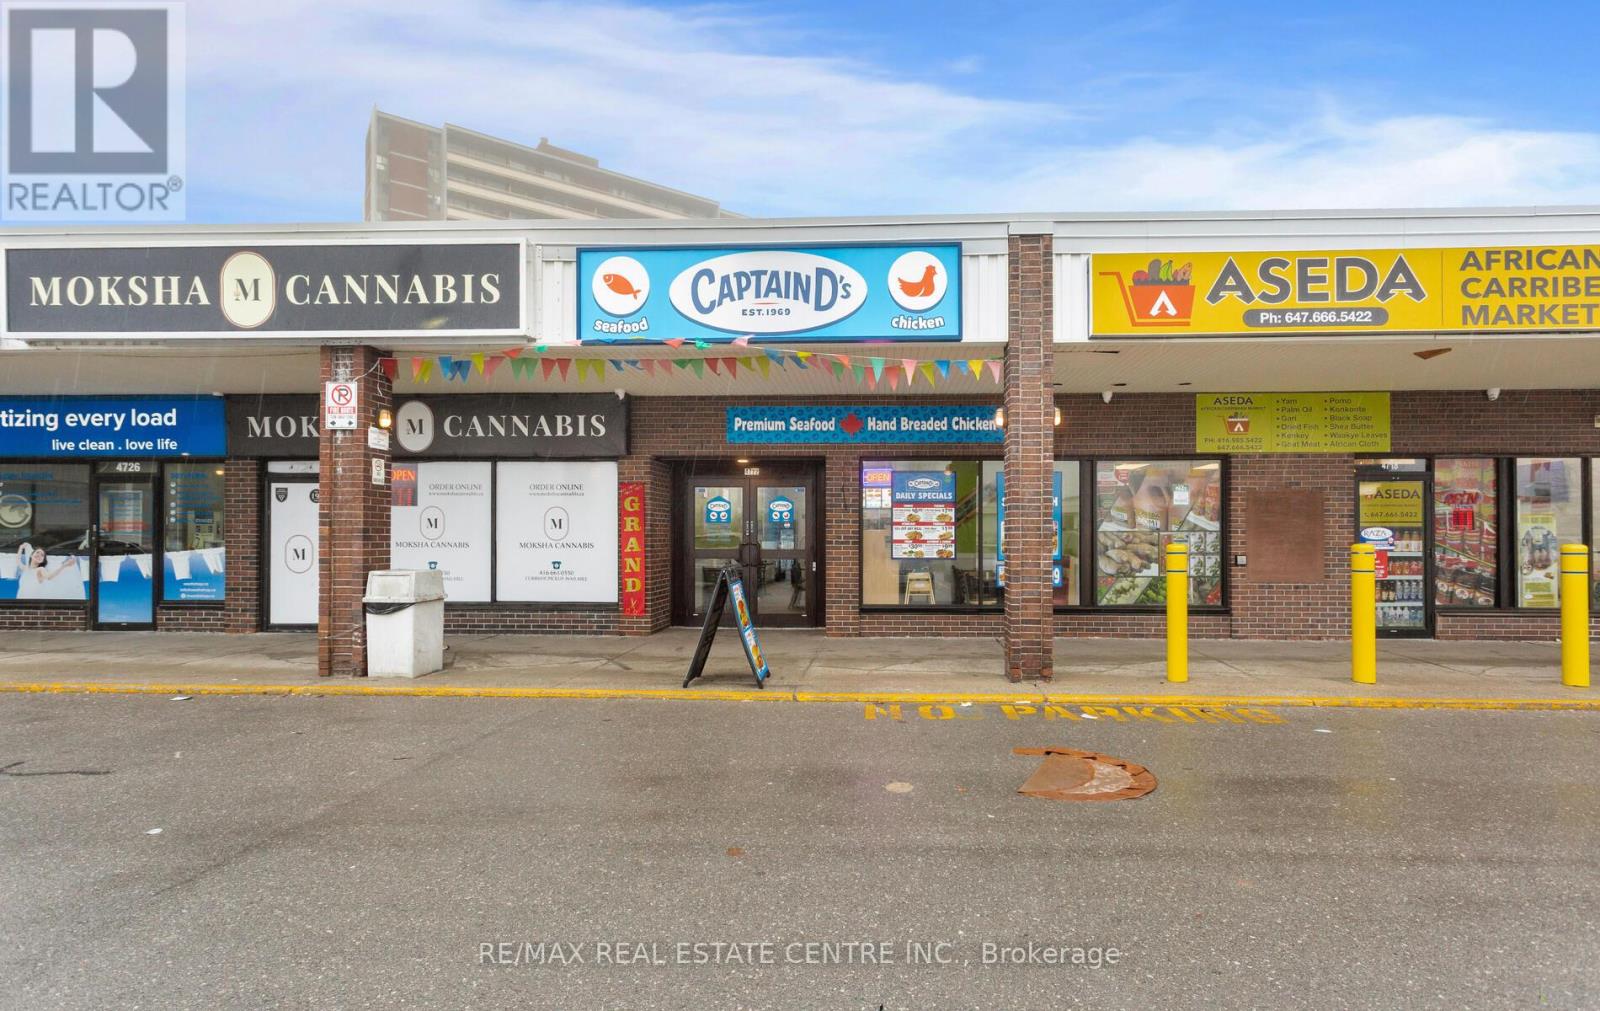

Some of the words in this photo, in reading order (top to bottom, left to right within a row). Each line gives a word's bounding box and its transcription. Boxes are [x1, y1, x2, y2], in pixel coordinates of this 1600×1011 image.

[1460, 249, 1600, 271] AFRICAN
[1205, 254, 1427, 306] ASEDA
[1461, 276, 1600, 299] CARRIBE
[29, 275, 212, 307] MOKSHA
[285, 272, 501, 306] CANNABIS
[890, 314, 945, 331] chicken
[1259, 312, 1283, 325] Ph:
[1284, 310, 1373, 324] 647.666.5422
[1461, 303, 1600, 326] MARKET
[1213, 396, 1254, 406] ASEDA
[0, 408, 59, 432] tizing
[65, 412, 125, 431] every
[130, 407, 177, 426] load
[443, 414, 606, 438] CANNABIS
[734, 416, 786, 431] Premium
[789, 416, 835, 431] Seafood
[867, 416, 897, 431] Hand
[900, 416, 948, 431] Breaded
[951, 416, 997, 431] Chicken
[51, 438, 76, 451] live
[78, 438, 114, 451] clean
[125, 438, 154, 450] love
[156, 438, 178, 450] life
[115, 462, 141, 472] 4726
[895, 492, 916, 500] DAILY
[918, 492, 953, 500] SPECIALS
[1374, 488, 1421, 499] ASEDA
[395, 541, 429, 549] MOKSHA
[430, 541, 470, 549] CANNABIS
[623, 496, 642, 593] GRAND
